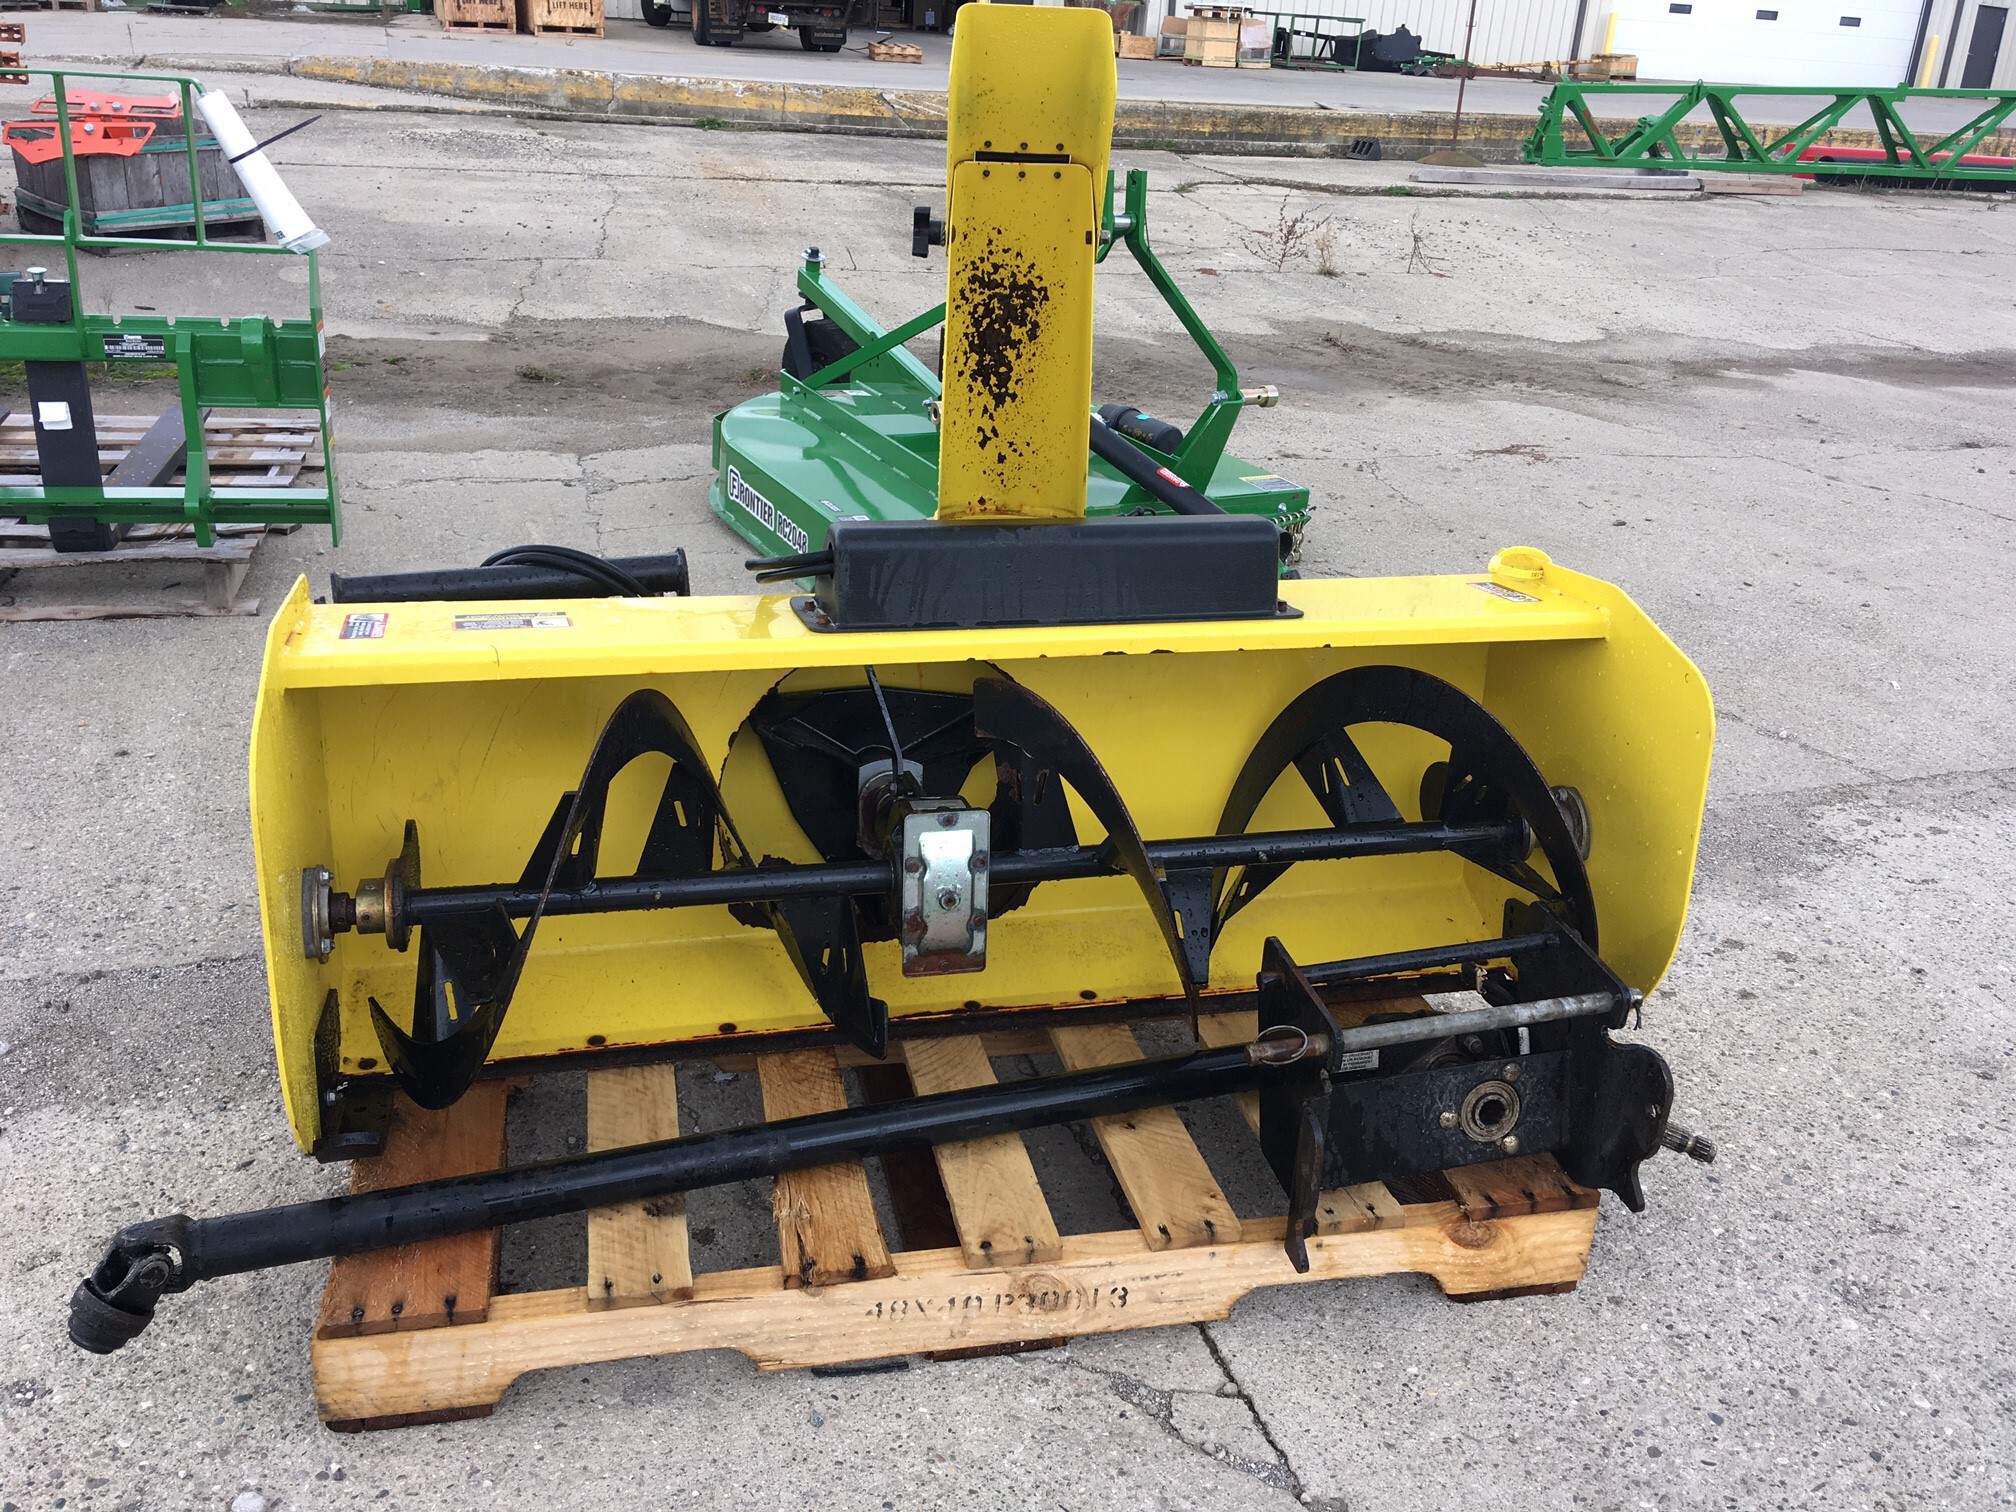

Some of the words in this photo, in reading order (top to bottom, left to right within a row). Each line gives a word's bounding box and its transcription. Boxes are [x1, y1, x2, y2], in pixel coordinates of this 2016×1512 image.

[553, 1, 566, 9] LIFT
[570, 2, 588, 10] HERE
[729, 467, 773, 529] FRONTIER
[777, 513, 807, 553] RC2048
